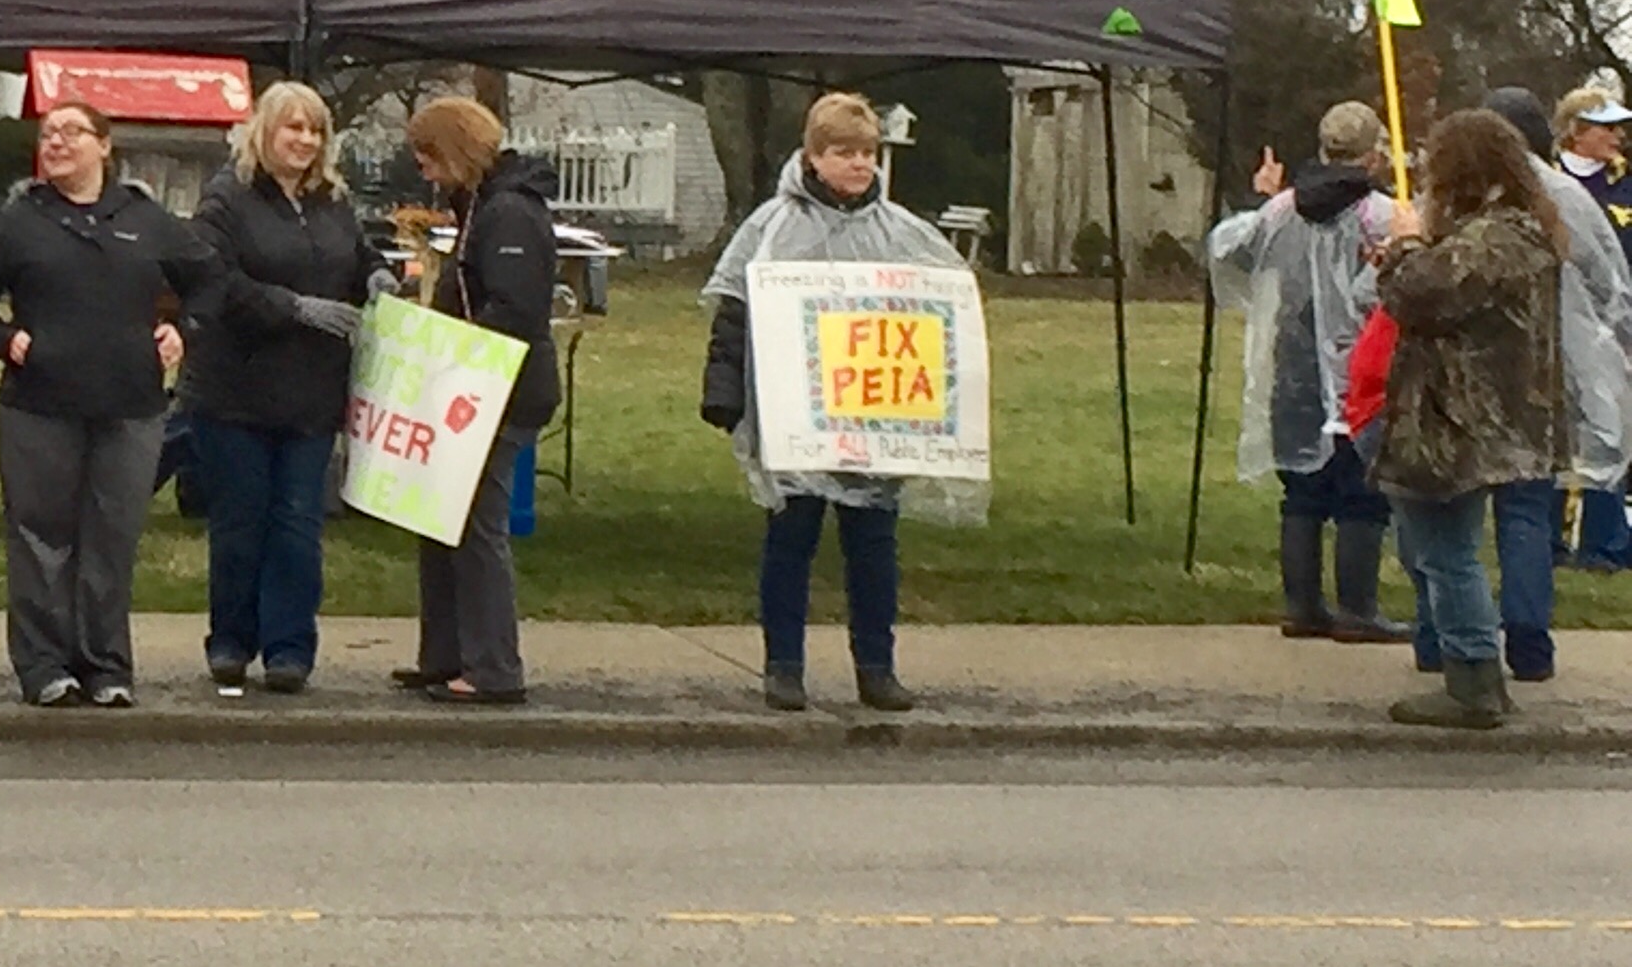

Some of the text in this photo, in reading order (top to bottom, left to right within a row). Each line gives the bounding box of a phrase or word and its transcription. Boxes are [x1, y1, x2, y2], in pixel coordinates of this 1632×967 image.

[874, 267, 918, 290] NOT
[848, 319, 919, 360] FIX
[832, 365, 935, 407] PEIA
[342, 395, 436, 465] EVER
